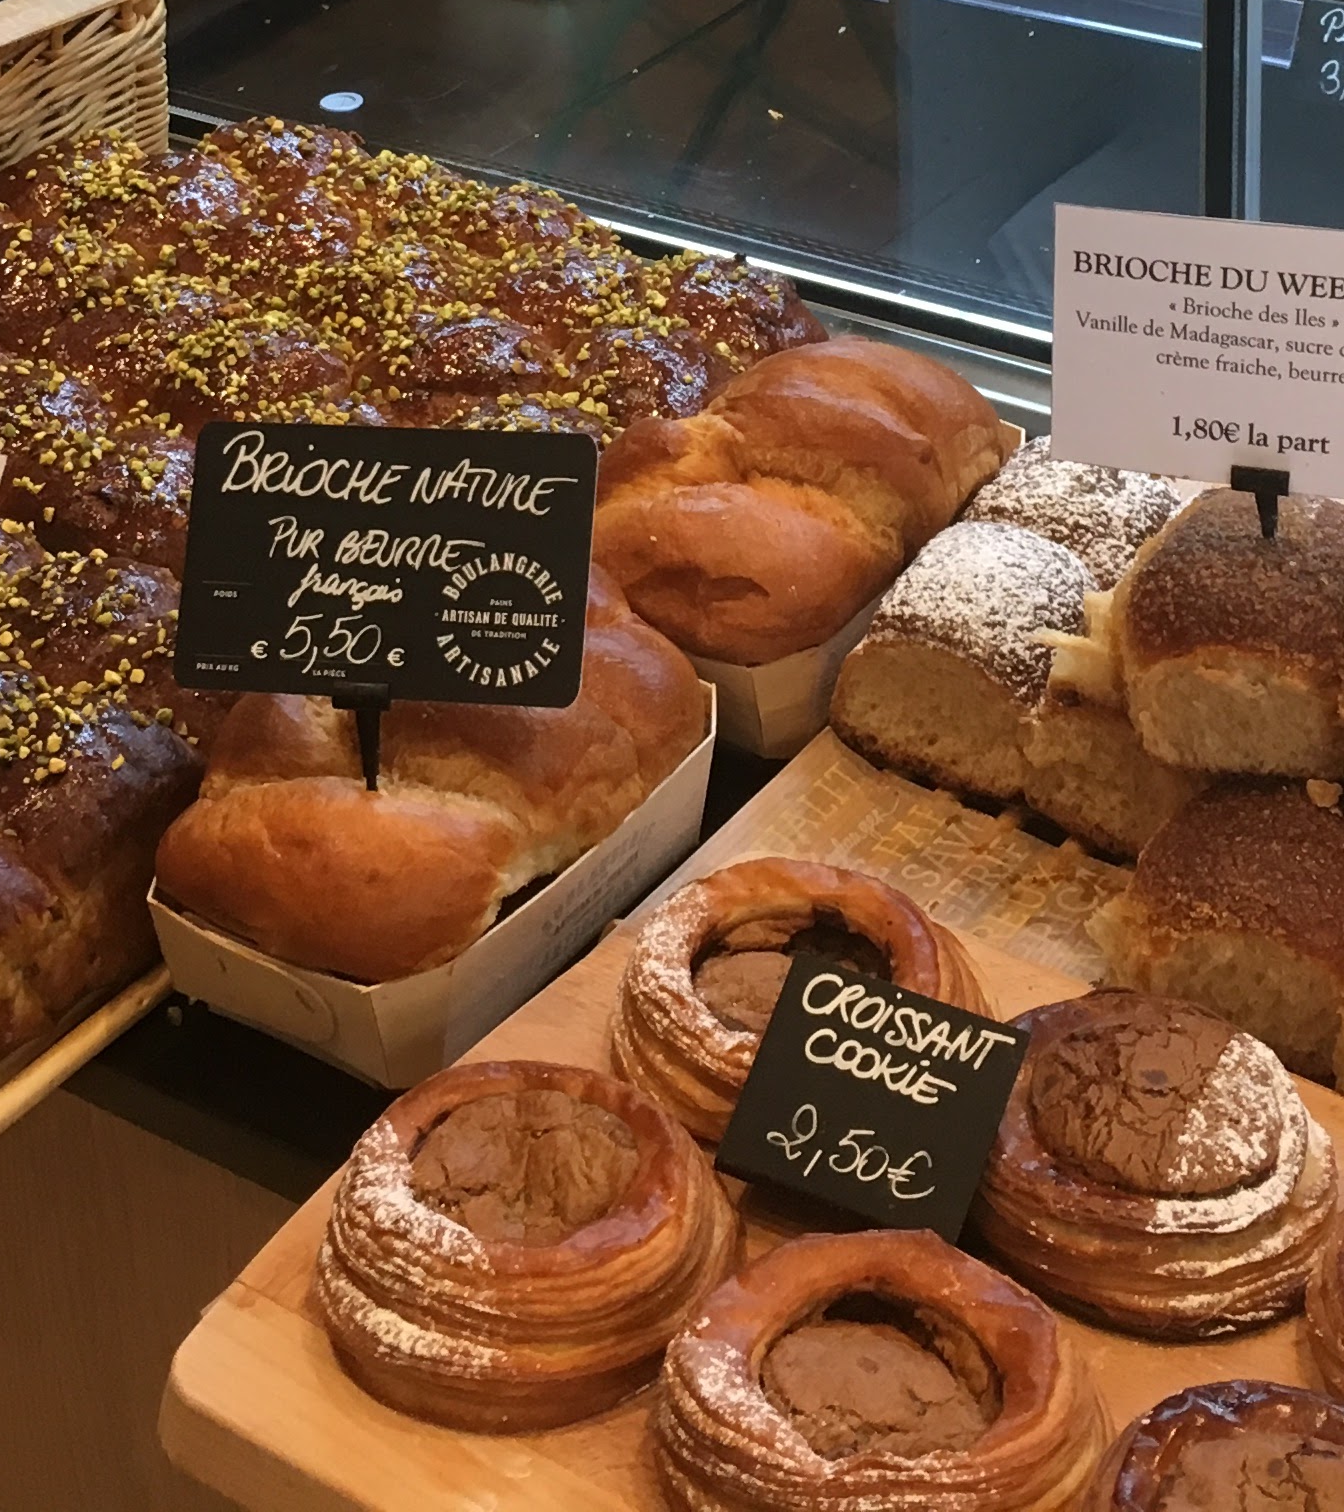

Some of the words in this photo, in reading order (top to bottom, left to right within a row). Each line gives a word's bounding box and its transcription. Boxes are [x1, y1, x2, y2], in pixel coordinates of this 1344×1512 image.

[1074, 250, 1212, 286] BRIOCHE
[1221, 266, 1268, 292] DU
[1076, 310, 1138, 335] Vanille
[1143, 318, 1164, 338] de
[1170, 321, 1279, 351] Madagascar,
[1286, 339, 1333, 357] sucre
[1183, 297, 1253, 321] Brioche
[1259, 305, 1288, 325] des
[1295, 308, 1325, 329] Iles
[1156, 351, 1210, 371] crème
[1215, 353, 1282, 380] fraiche,
[1172, 415, 1240, 443] 1,80€
[1248, 422, 1268, 447] la
[1277, 431, 1330, 454] part
[221, 431, 410, 505] BRIOCHE
[410, 458, 578, 516] NATURE
[268, 515, 324, 558] PUR
[335, 529, 485, 571] BEURRE
[288, 563, 405, 610] français
[442, 553, 563, 605] BOULANGERIE
[442, 609, 490, 623] ARTISAN
[494, 612, 508, 624] DE
[485, 631, 527, 639] TRADITION
[251, 641, 268, 659] €
[280, 614, 381, 673] 5,50
[387, 648, 405, 666] €
[437, 633, 560, 687] ARTISANALE
[802, 973, 1016, 1070] CROISSANT
[805, 1028, 957, 1104] COOKIE
[766, 1104, 935, 1199] 2,50€
